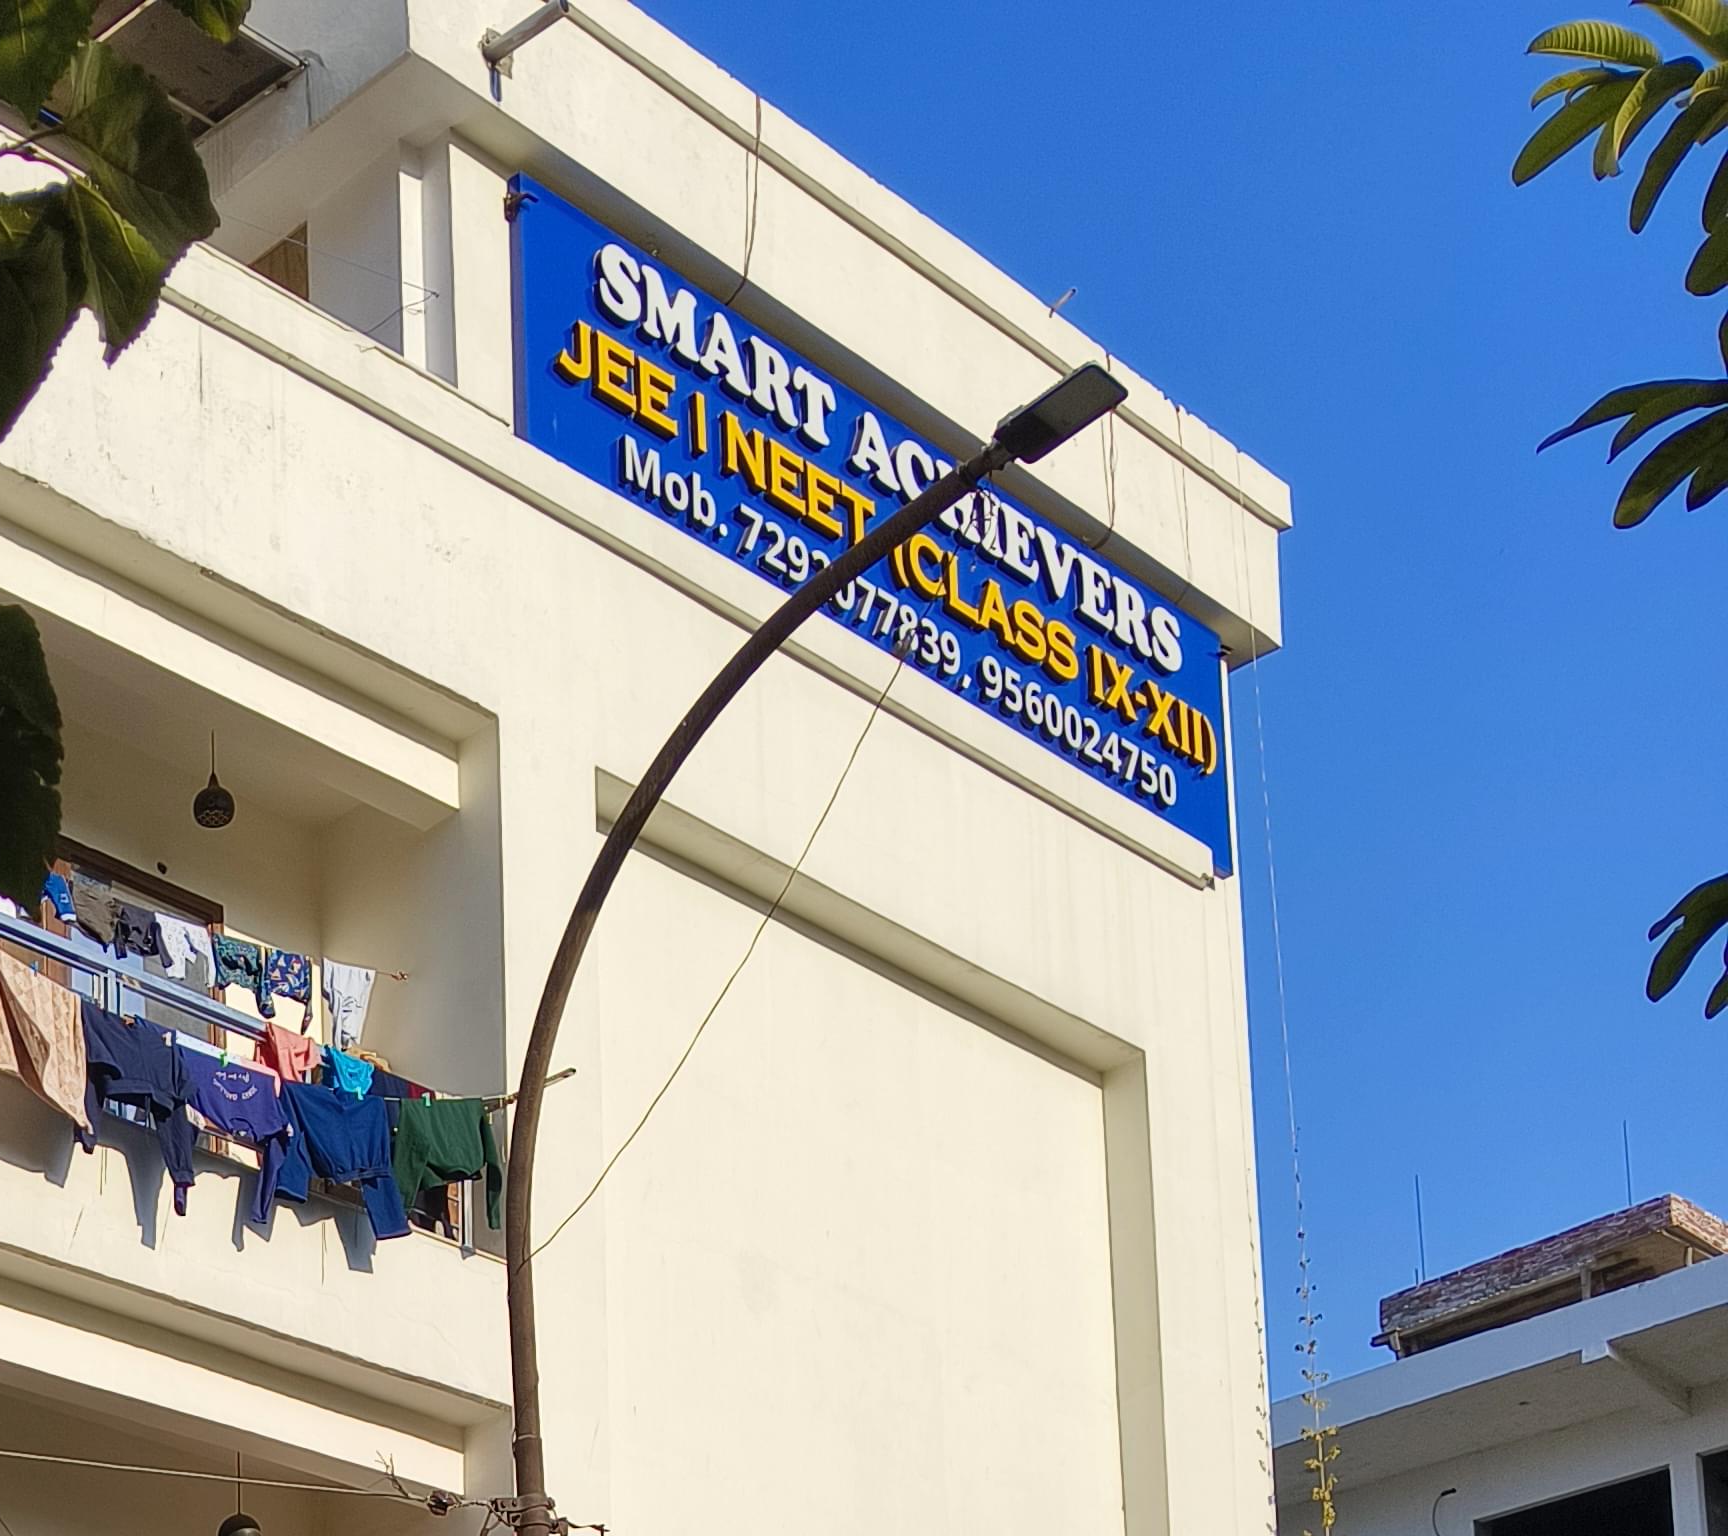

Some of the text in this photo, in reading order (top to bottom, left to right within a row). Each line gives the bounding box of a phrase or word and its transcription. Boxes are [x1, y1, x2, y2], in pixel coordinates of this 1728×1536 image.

[595, 244, 837, 447] SMART
[555, 320, 678, 438] JEE
[721, 409, 876, 544] NEET
[893, 533, 1080, 682] (CLASS
[1087, 643, 1218, 775] IX-XII)
[624, 434, 729, 540] Mob.
[981, 653, 1178, 806] 9560024750
